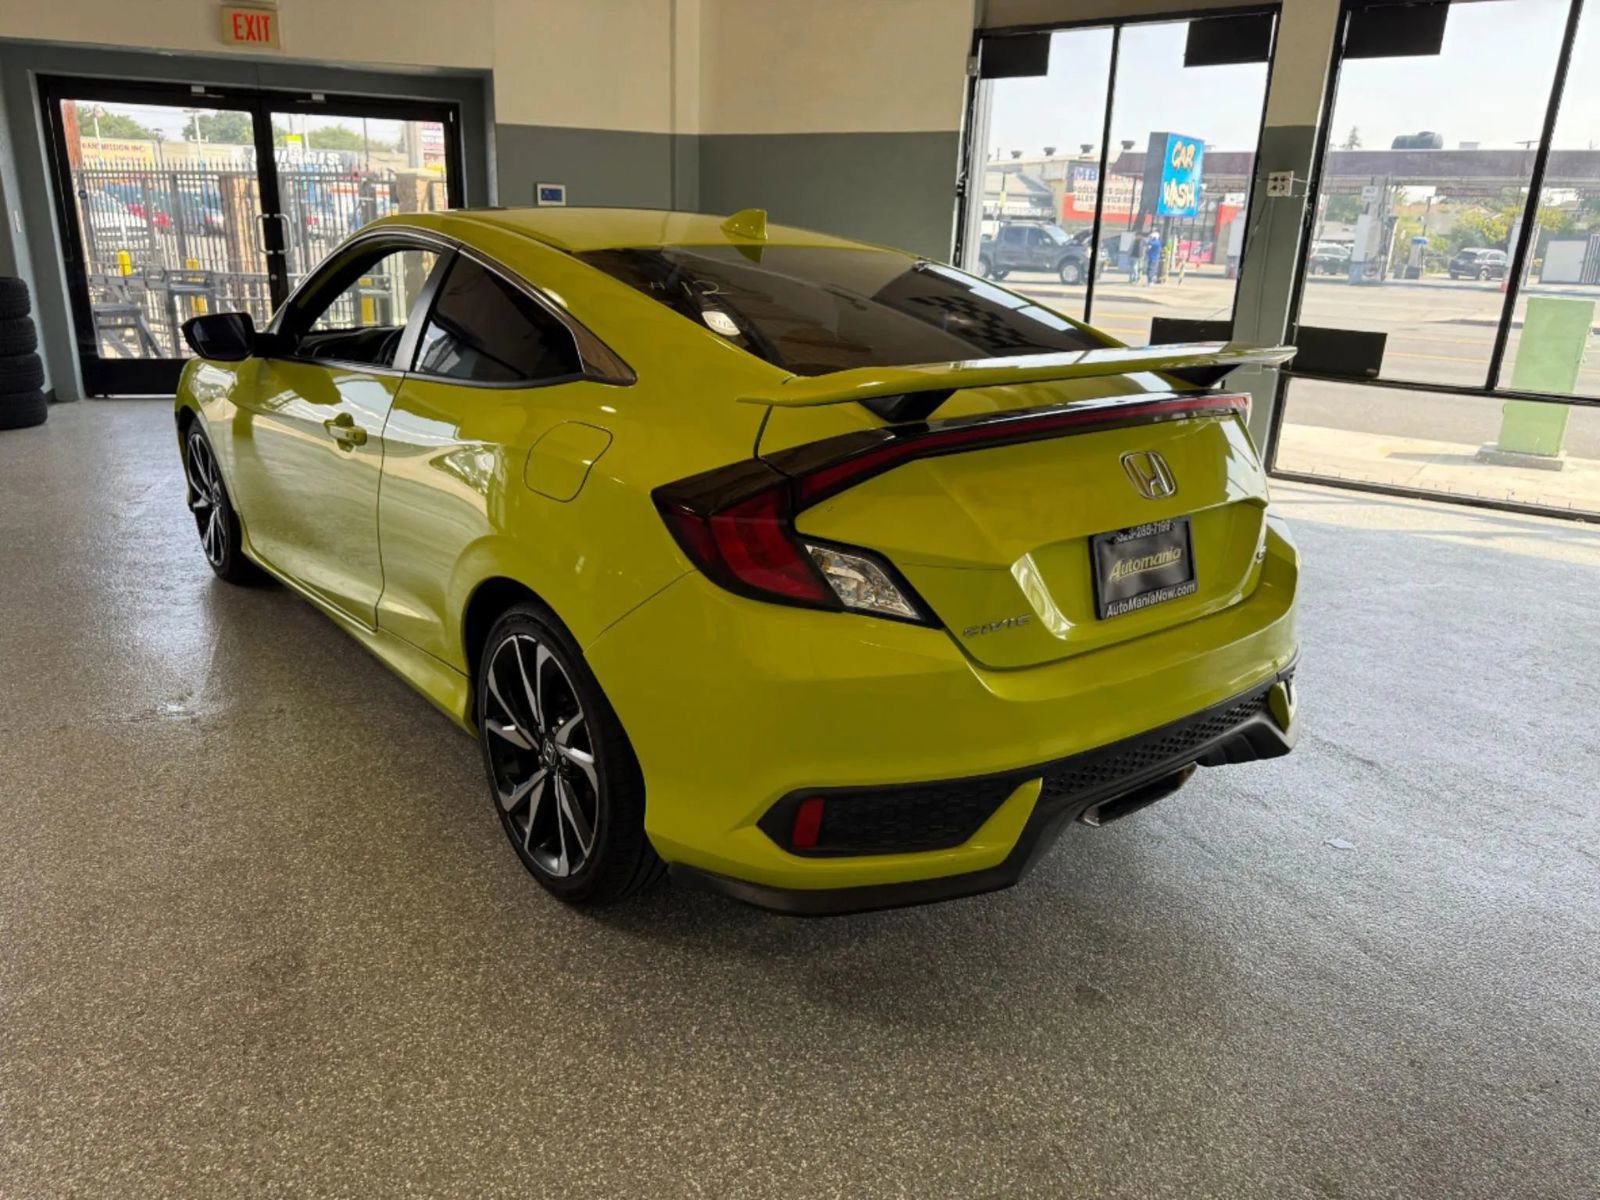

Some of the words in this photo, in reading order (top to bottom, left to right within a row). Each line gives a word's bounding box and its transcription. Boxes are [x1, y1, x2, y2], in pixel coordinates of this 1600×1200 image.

[232, 12, 270, 42] EXIT
[1171, 140, 1195, 170] CAR
[1163, 177, 1196, 209] WASH
[1109, 546, 1182, 583] Automania
[1106, 583, 1196, 617] AutoManiaNow.com
